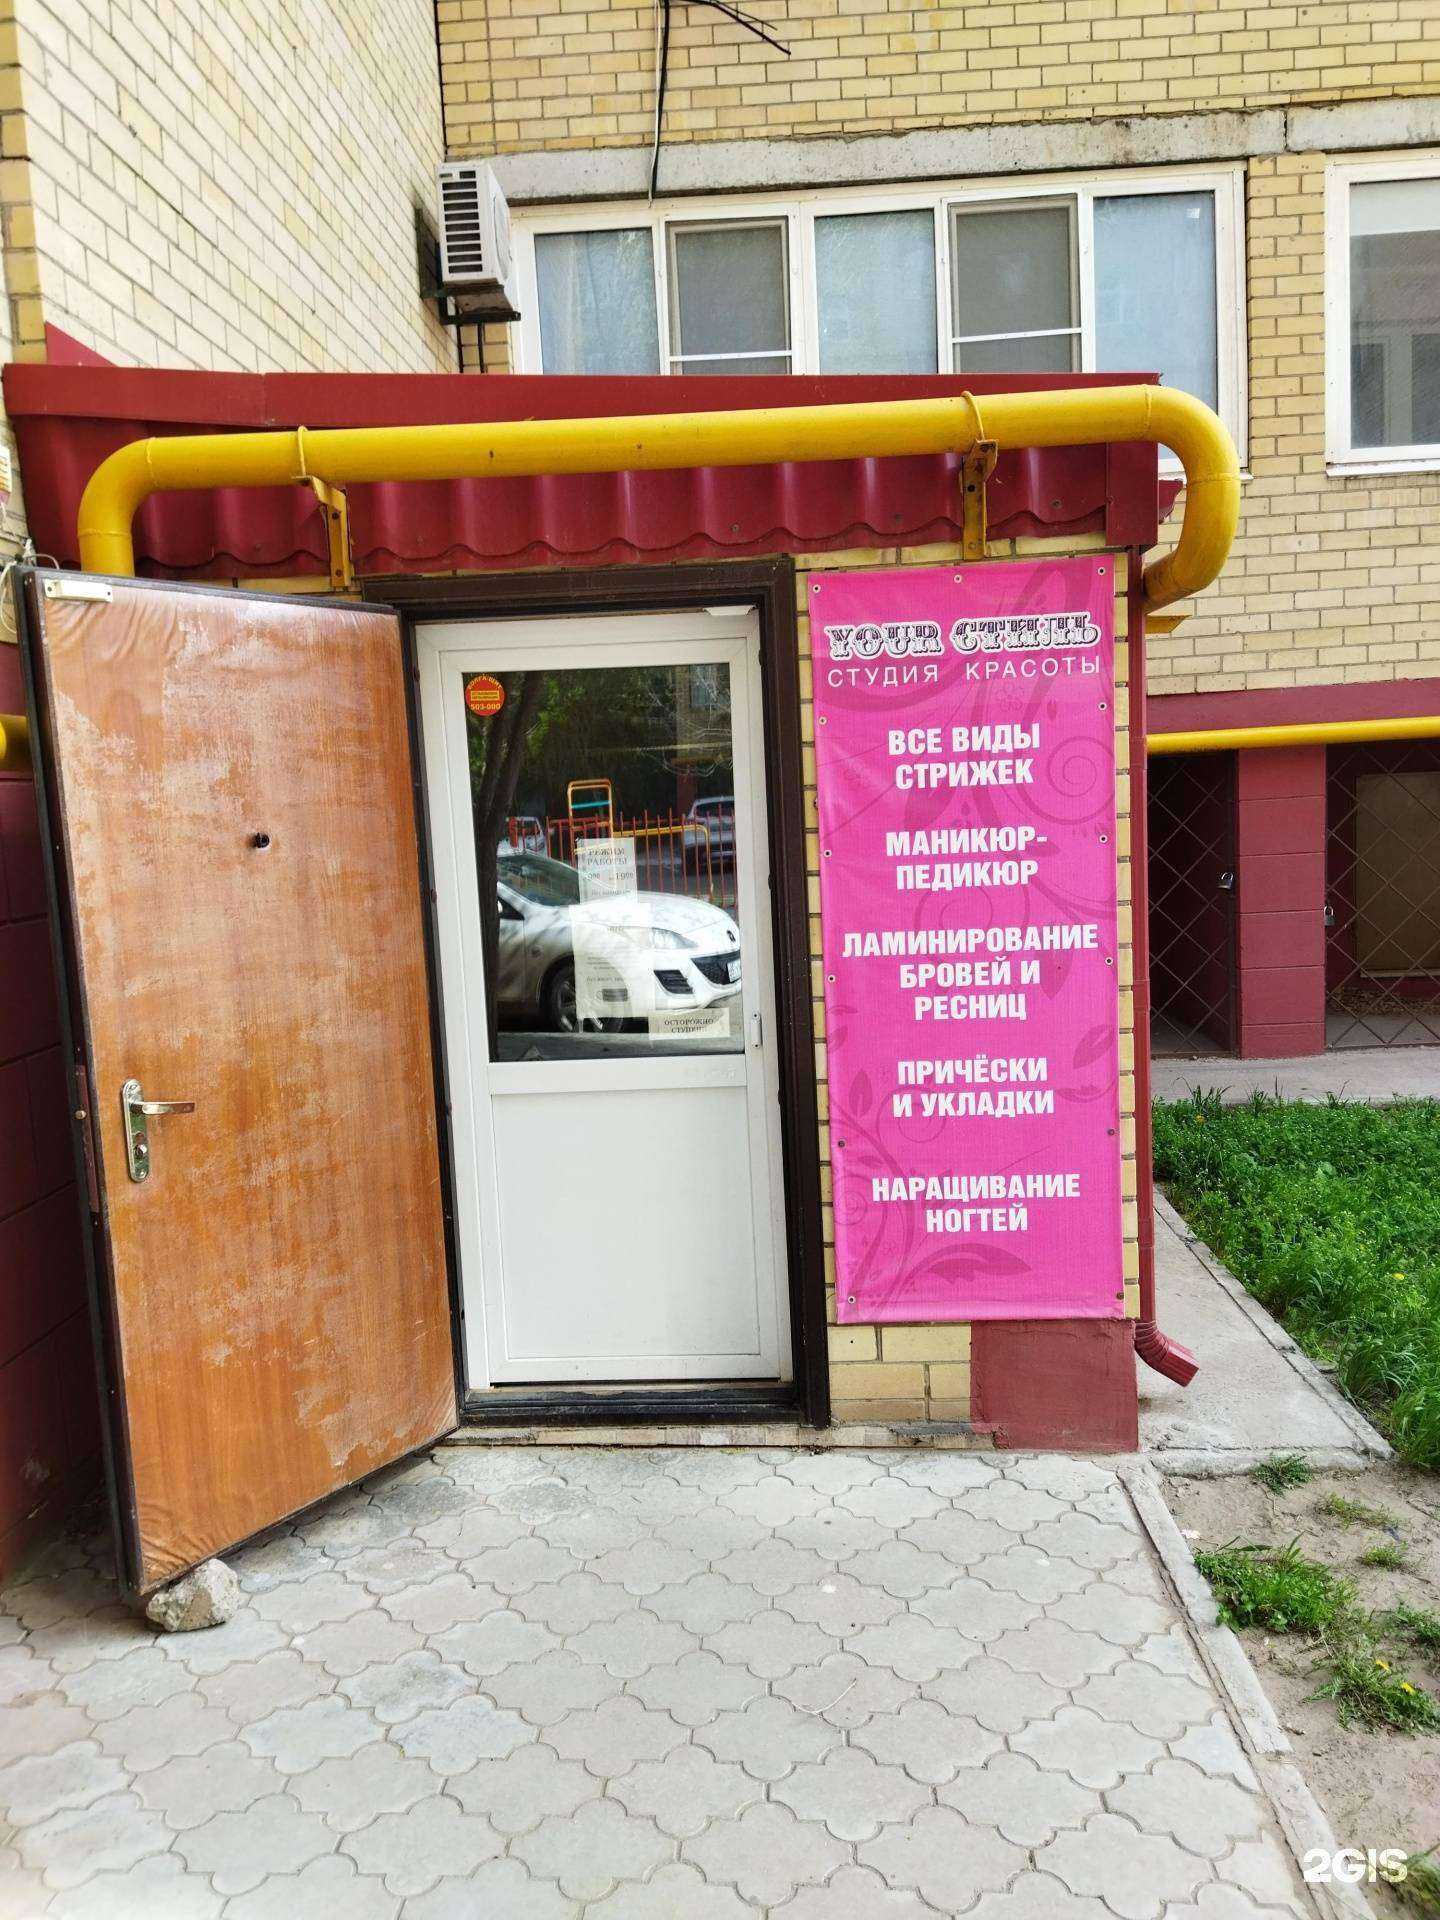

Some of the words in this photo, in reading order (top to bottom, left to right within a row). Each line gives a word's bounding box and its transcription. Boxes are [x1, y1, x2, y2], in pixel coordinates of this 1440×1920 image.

[825, 624, 945, 660] YOUR
[950, 612, 1101, 653] СТИЛЬ
[828, 665, 939, 688] СТУДИЯ
[966, 656, 1100, 681] КРАСОТЫ
[888, 728, 942, 756] ВСЕ
[952, 723, 1040, 753] ВИДЫ
[895, 759, 1034, 790] СТРИЖЕК
[886, 826, 1047, 856] МАНИКЮР-
[896, 860, 1038, 891] ПЕДИКЮР
[842, 924, 1098, 957] ЛАМИНИРОВАНИЕ
[899, 956, 1010, 988] БРОВЕЙ
[1021, 960, 1040, 984] И
[915, 994, 1027, 1020] РЕСНИЦ
[897, 1054, 1048, 1085] ПРИЧЁСКИ
[892, 1094, 912, 1118] И
[921, 1090, 1055, 1118] УКЛАДКИ
[872, 1174, 1081, 1202] НАРАЩИВАНИЕ
[926, 1203, 1028, 1233] НОГТЕЙ
